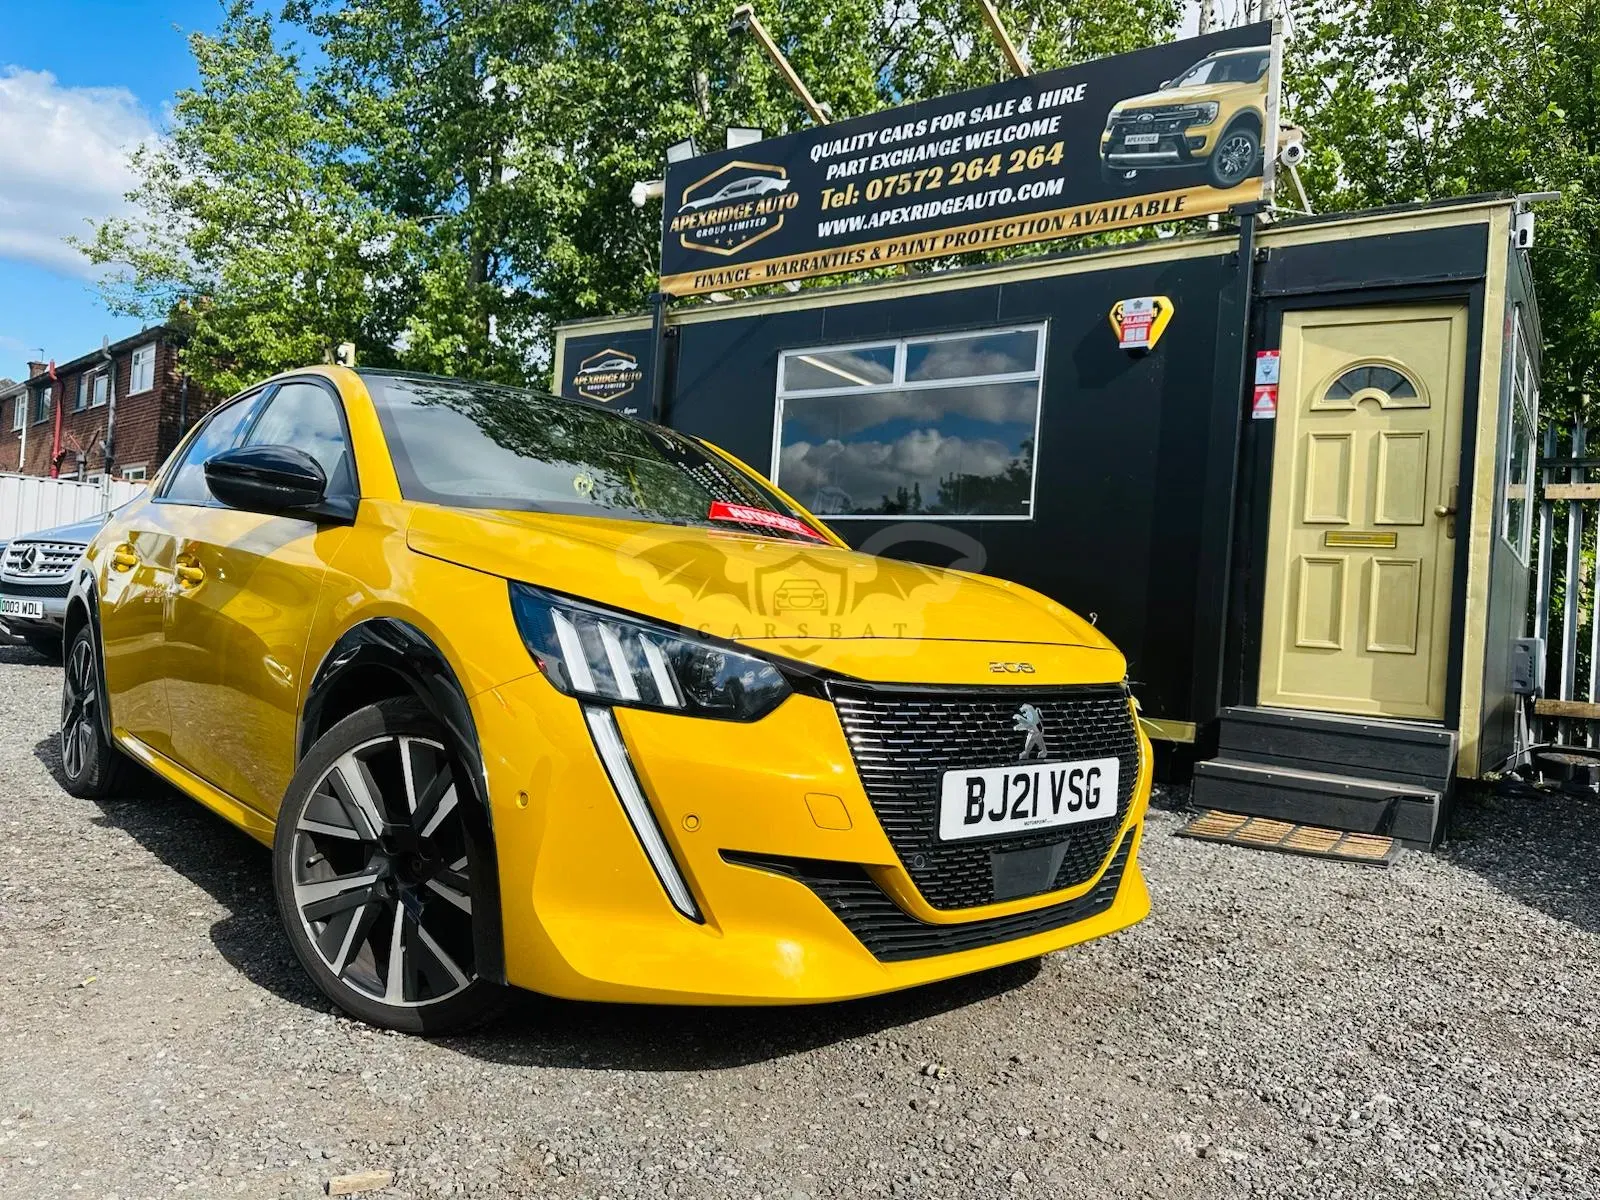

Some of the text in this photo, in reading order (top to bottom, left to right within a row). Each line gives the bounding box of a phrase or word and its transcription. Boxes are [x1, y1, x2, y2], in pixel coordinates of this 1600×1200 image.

[810, 83, 1088, 163] QUALITY CARS FOR SALE & HIRE
[826, 115, 1062, 181] PART EXCHANGE WELCOME
[821, 141, 1065, 210] Tel: 07572 264 264
[669, 191, 799, 233] APEXRIDGE AUTO
[696, 217, 767, 238] GROUP LIMITED
[818, 177, 1065, 238] WWW.APEXRIDGEAUTO.COM
[693, 266, 751, 289] FINANCE
[765, 247, 865, 278] WARRANTIES
[869, 245, 881, 260] &
[886, 237, 938, 258] PAINT
[943, 214, 1066, 250] PROTECTION
[1069, 194, 1188, 229] AVAILABLE
[572, 370, 642, 386] APEXRIDGE AUTO
[22, 601, 41, 615] WDL
[988, 661, 1036, 674] 208
[964, 767, 1102, 825] BJ21 VSG
